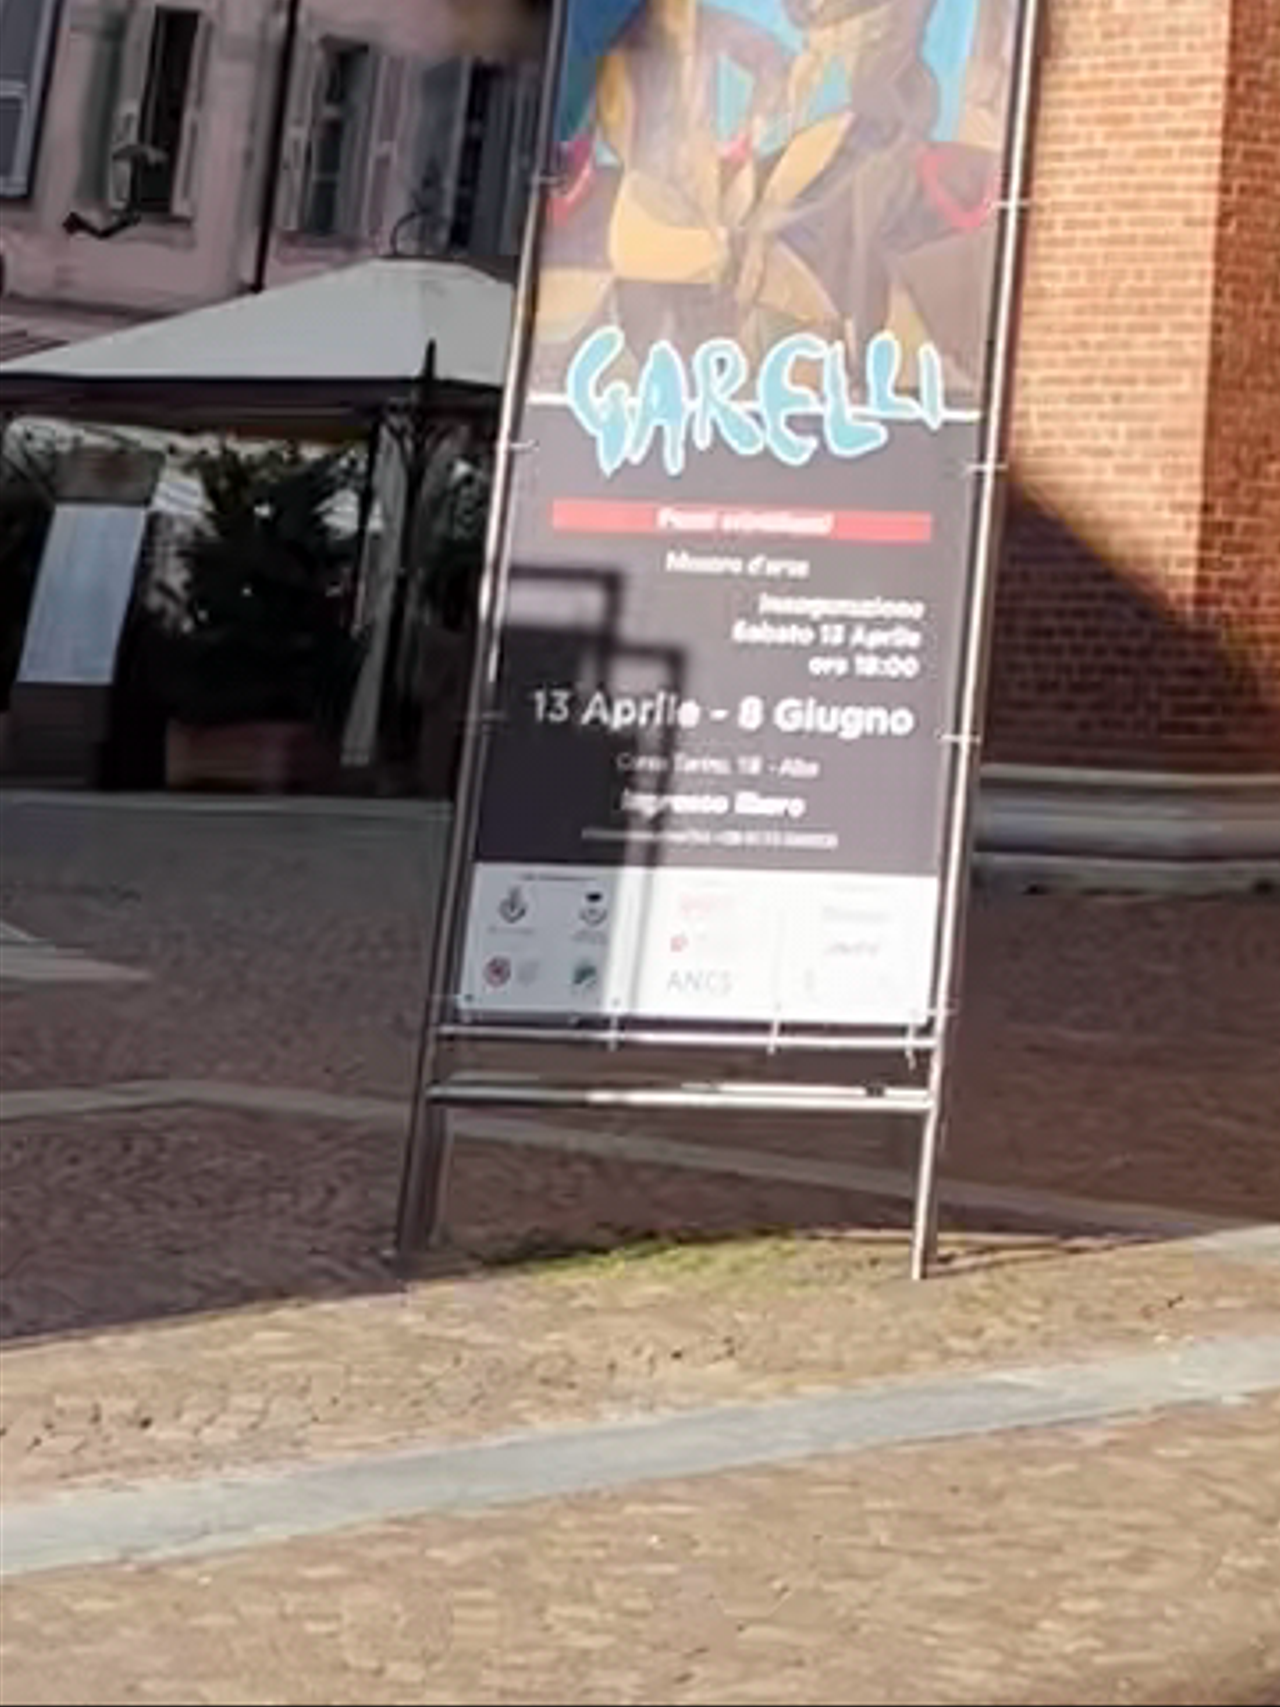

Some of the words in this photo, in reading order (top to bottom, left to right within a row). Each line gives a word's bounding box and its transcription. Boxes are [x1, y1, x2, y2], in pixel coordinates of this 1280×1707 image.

[567, 323, 943, 477] GARELLI
[533, 689, 571, 723] 13
[581, 691, 700, 730] Aprile
[738, 696, 764, 730] 8
[773, 697, 914, 740] Giugno
